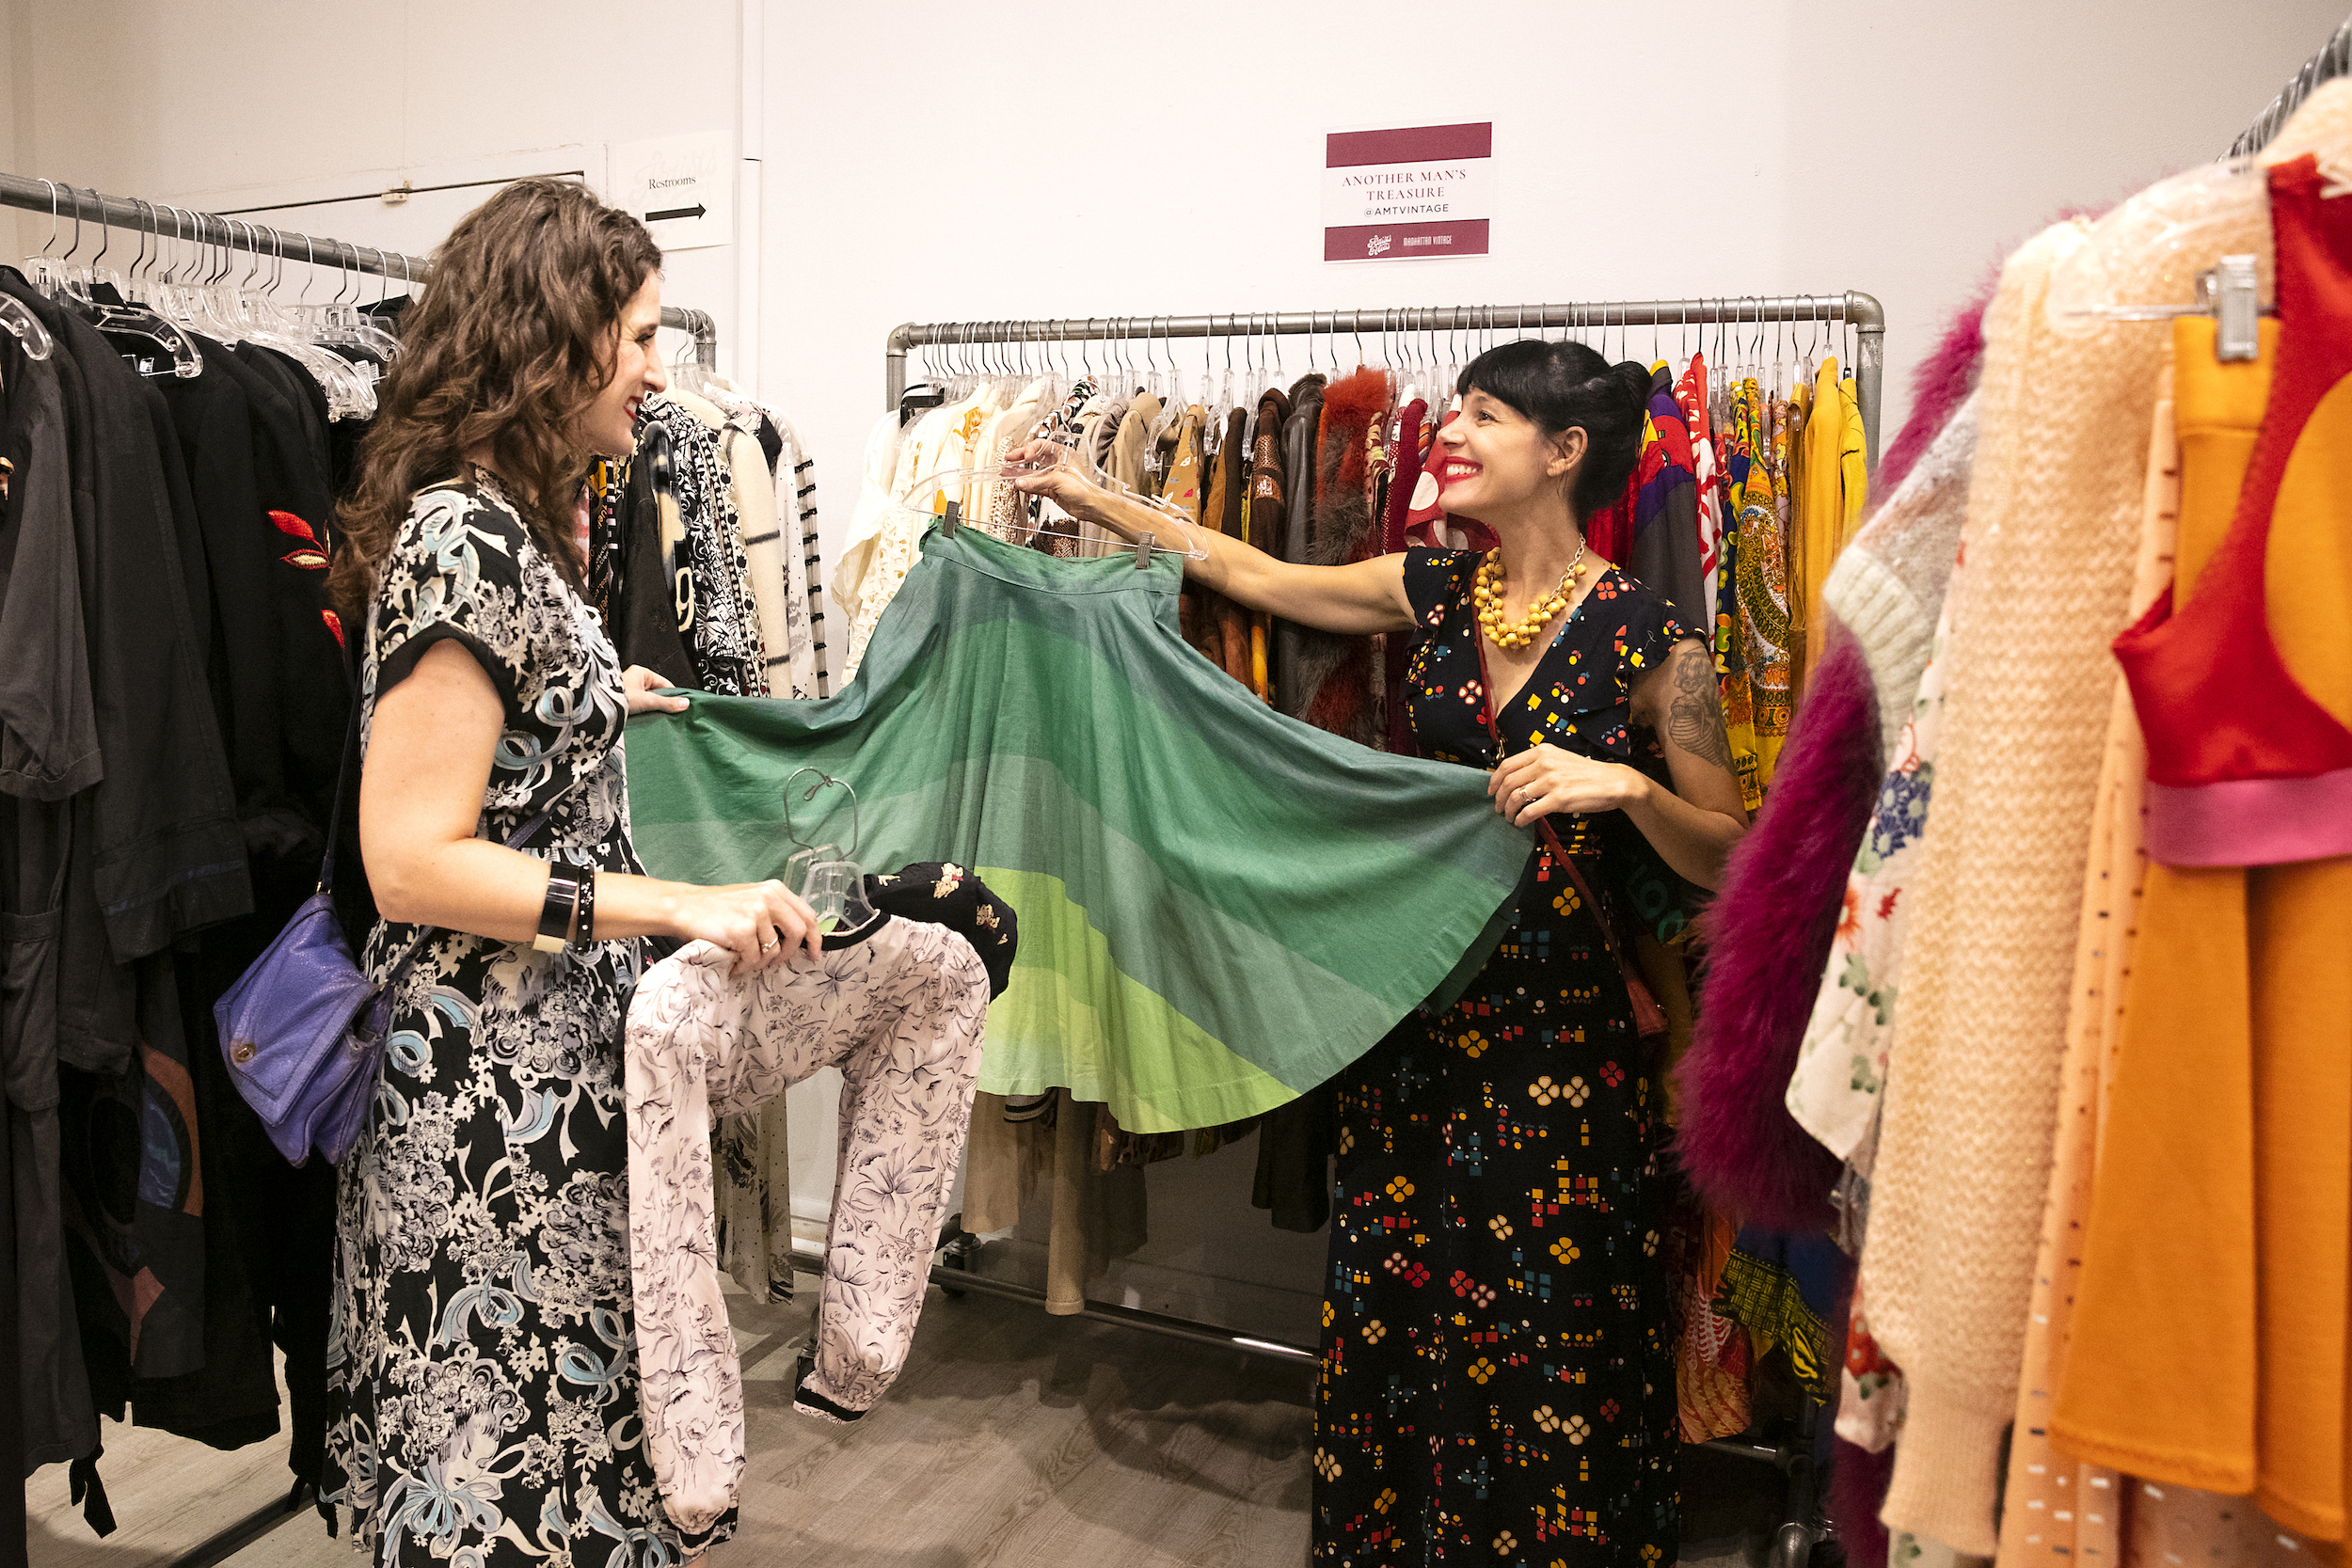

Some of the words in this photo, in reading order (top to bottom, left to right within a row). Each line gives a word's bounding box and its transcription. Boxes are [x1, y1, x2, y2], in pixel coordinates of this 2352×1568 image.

[648, 176, 696, 190] Restrooms
[1342, 172, 1415, 186] ANOTHER
[1420, 168, 1467, 182] MAN’S
[1366, 186, 1445, 201] TREASURE
[1363, 203, 1450, 218] @AMTVINTAGE
[1432, 234, 1452, 245] VINTAGE
